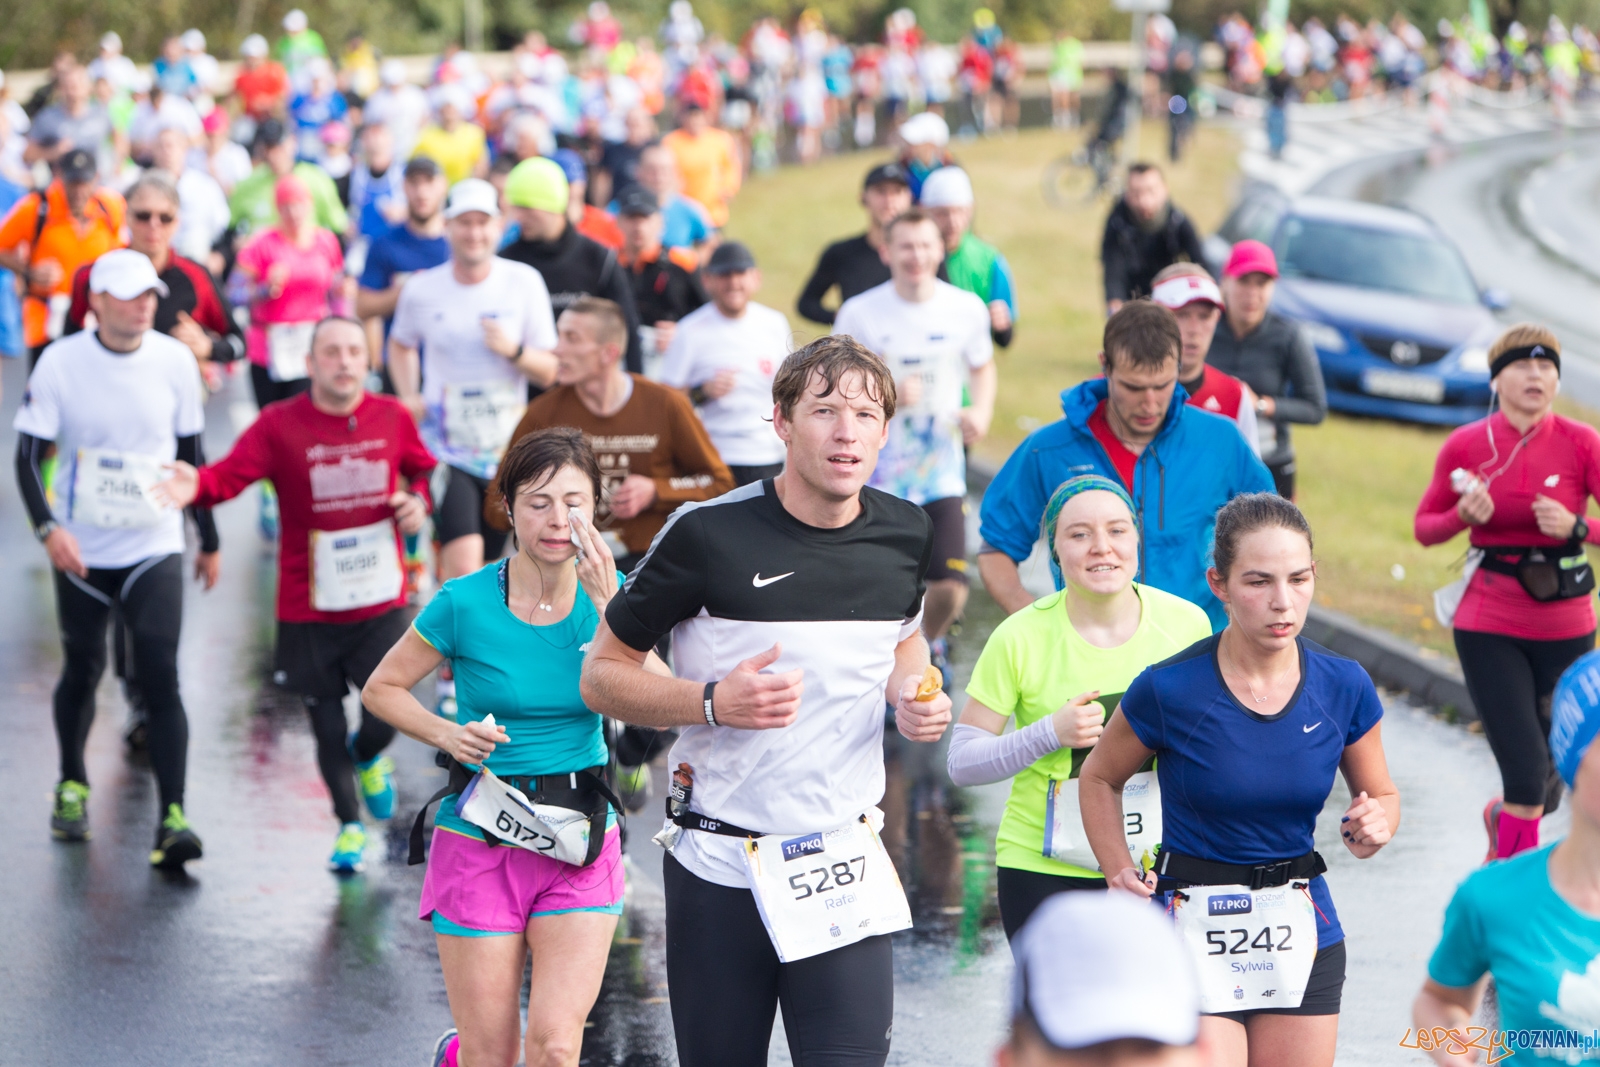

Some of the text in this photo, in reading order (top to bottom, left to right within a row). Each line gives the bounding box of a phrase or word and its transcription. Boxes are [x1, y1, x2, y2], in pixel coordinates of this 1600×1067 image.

[788, 855, 866, 901] 5287
[1206, 925, 1293, 956] 5242
[1231, 960, 1274, 974] Sylwia
